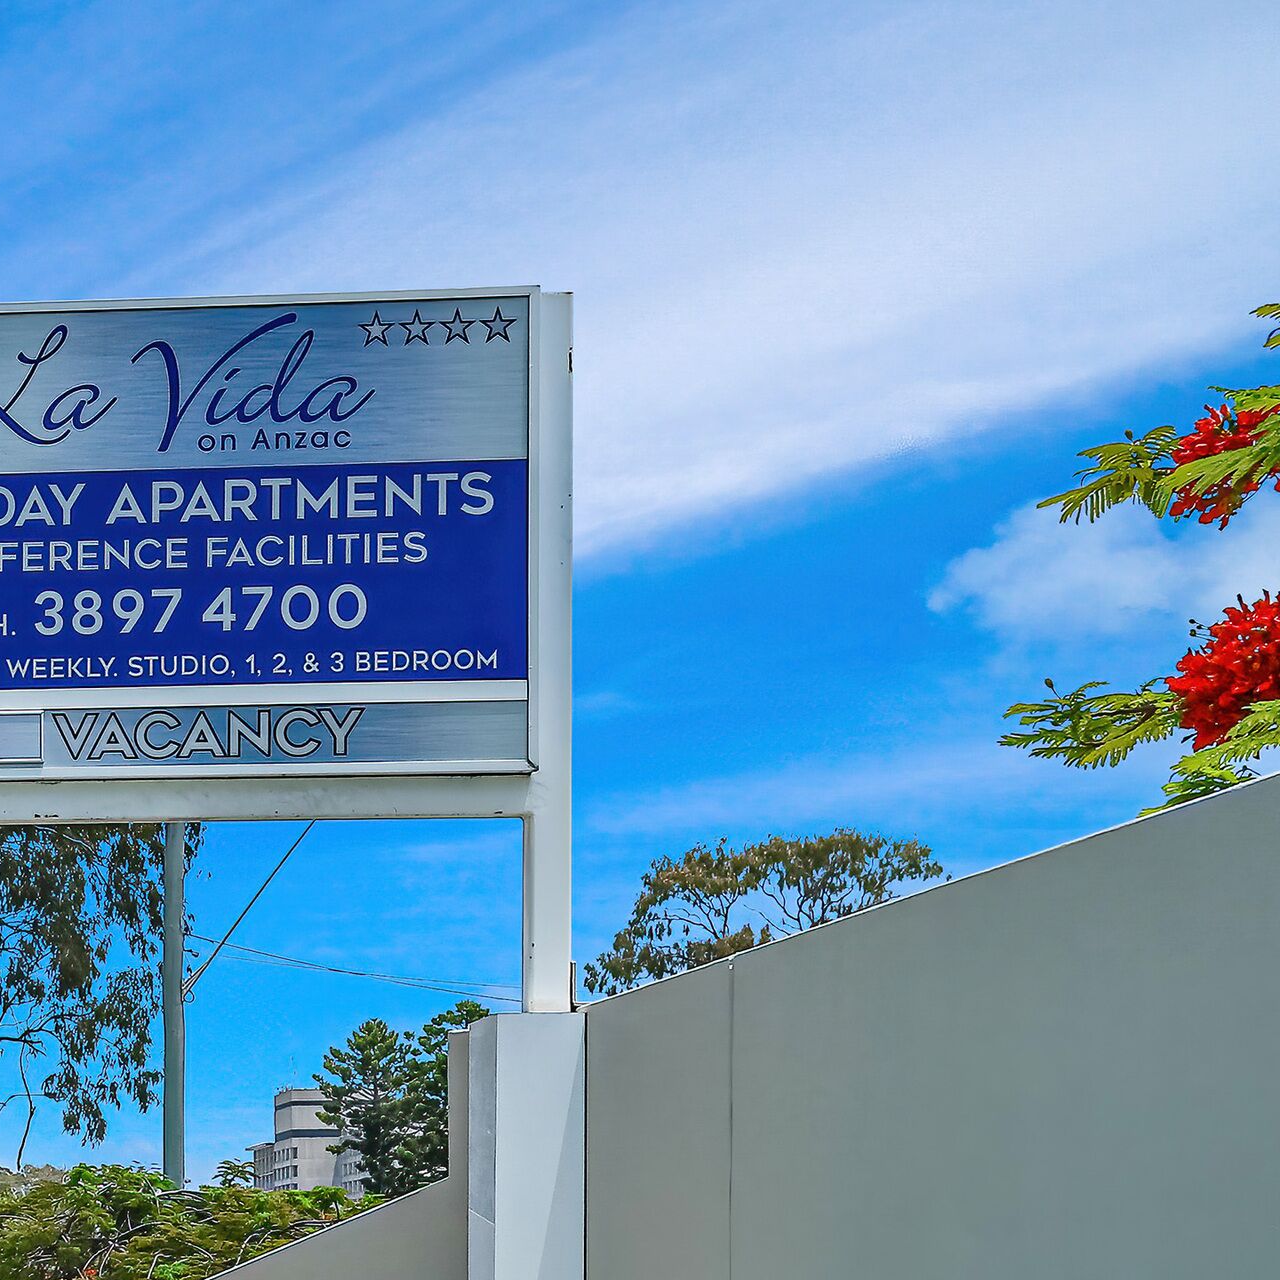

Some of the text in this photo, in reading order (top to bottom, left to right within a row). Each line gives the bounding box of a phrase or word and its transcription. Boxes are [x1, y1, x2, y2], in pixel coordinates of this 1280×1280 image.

[131, 312, 376, 453] Vida
[197, 428, 353, 452] on Anzac
[107, 471, 495, 526] APARTMENTS
[206, 531, 428, 568] FACILITIES
[34, 588, 182, 636] 3897
[202, 583, 368, 632] 4700
[128, 654, 236, 678] STUDIO,
[245, 653, 262, 677] 1,
[272, 652, 293, 677] 2,
[303, 652, 320, 673] &
[330, 651, 344, 673] 3
[355, 648, 498, 672] BEDROOM
[51, 707, 365, 760] VACANCY
